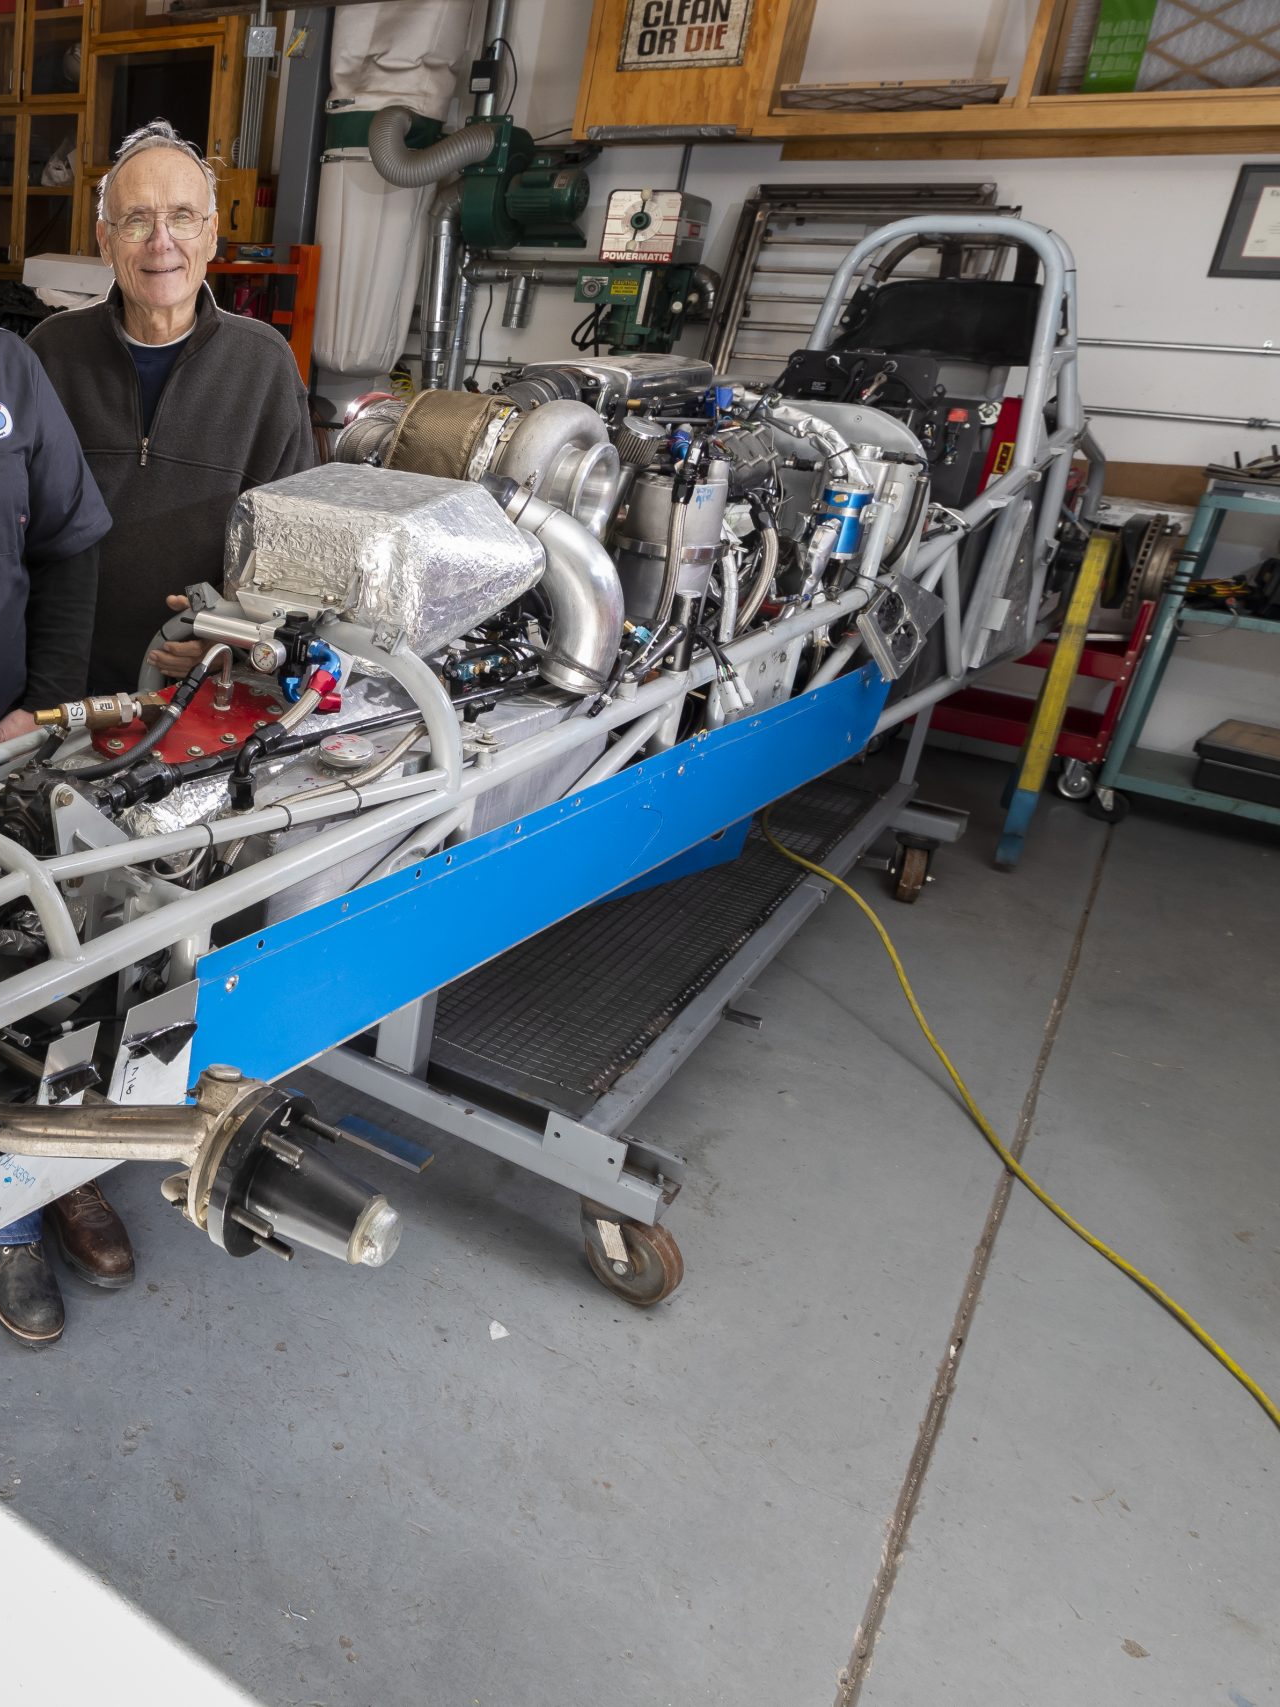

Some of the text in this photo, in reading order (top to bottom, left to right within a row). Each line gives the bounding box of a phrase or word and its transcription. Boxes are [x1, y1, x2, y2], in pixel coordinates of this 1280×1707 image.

[642, 0, 731, 28] CLEAN
[637, 24, 729, 56] OR DIE
[602, 251, 671, 262] POWERMATIC
